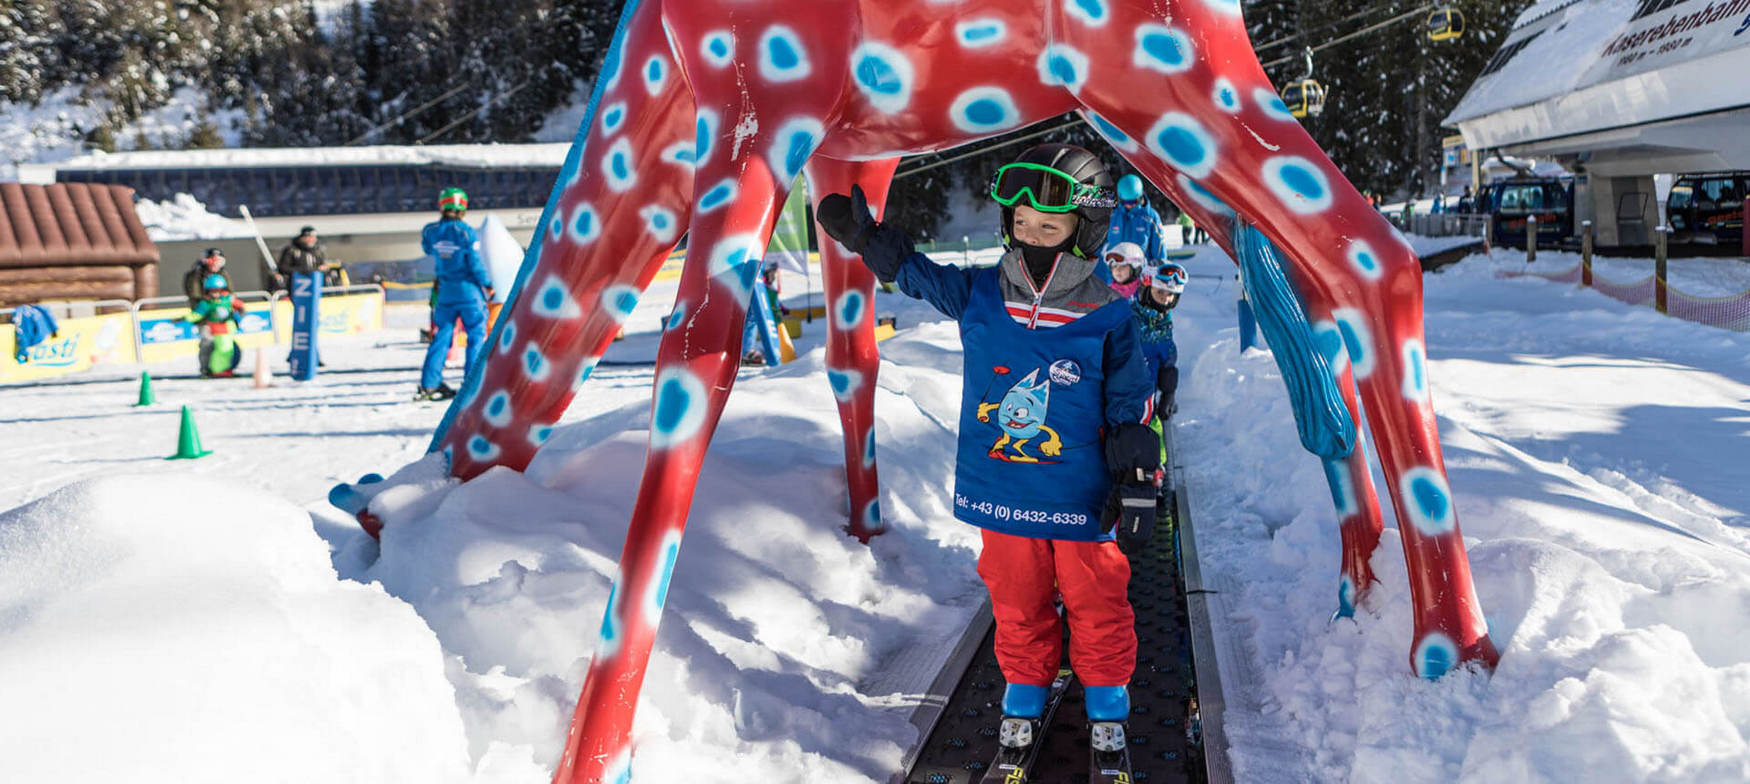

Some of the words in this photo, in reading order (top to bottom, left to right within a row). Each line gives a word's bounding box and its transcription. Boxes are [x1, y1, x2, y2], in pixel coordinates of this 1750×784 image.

[955, 493, 969, 509] Tel:
[971, 501, 993, 515] +43
[994, 504, 1010, 521] (0)
[1013, 509, 1087, 525] 6432-6339
